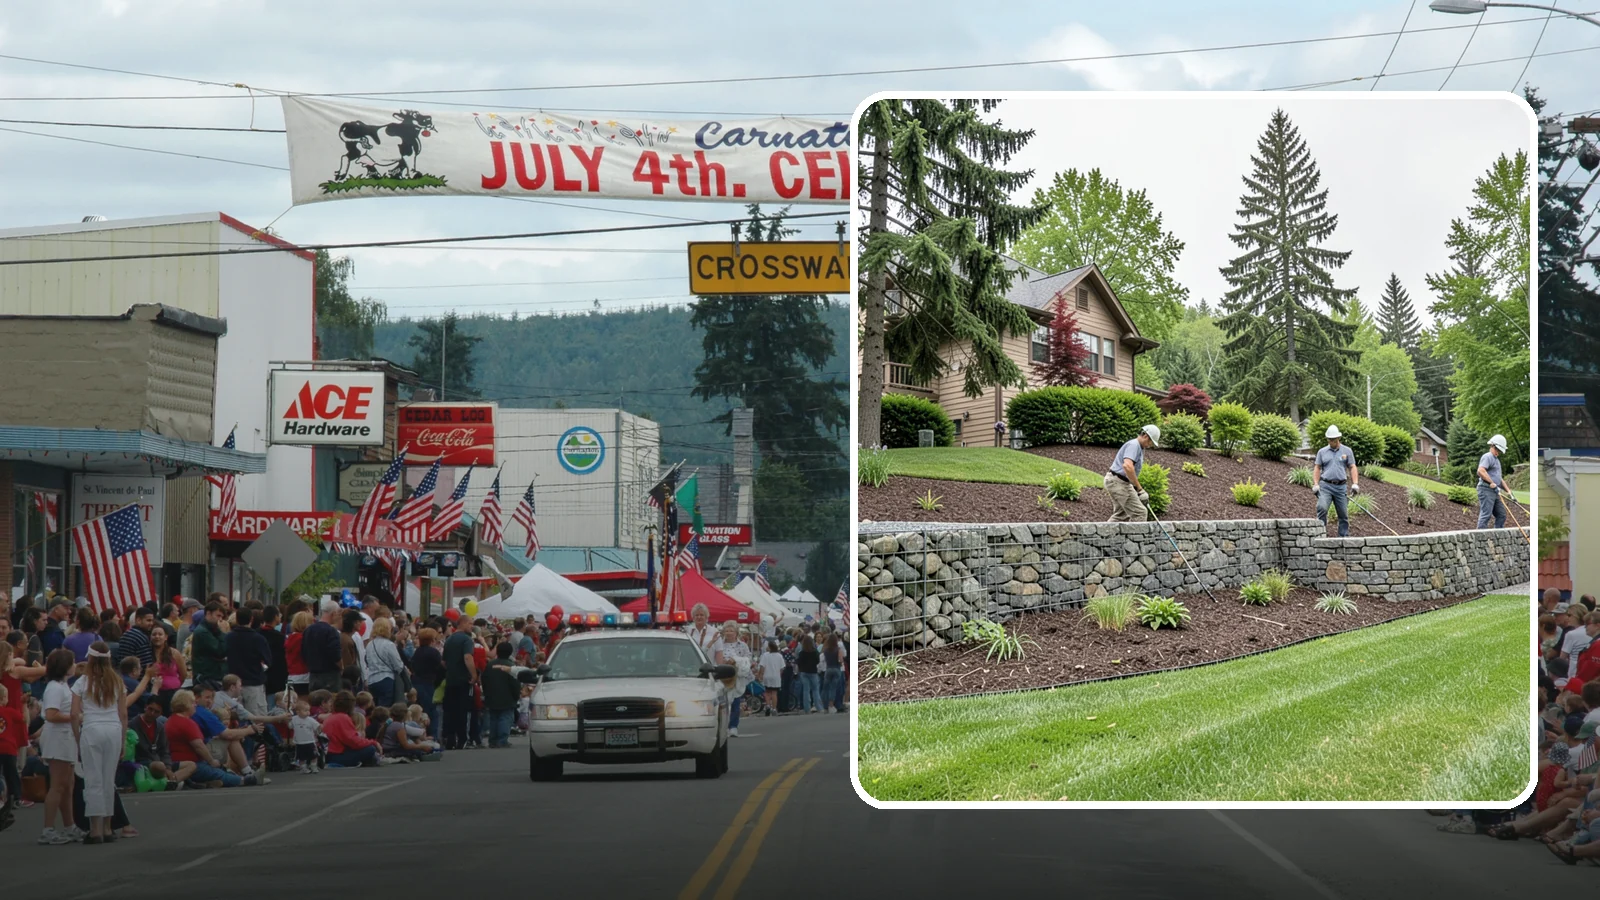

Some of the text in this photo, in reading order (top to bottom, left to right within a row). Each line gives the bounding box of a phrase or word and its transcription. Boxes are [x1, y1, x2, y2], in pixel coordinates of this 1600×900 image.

[481, 141, 605, 193] JULY
[632, 149, 747, 198] 4th.
[696, 254, 850, 280] CROSSWA
[282, 380, 374, 420] ACE
[405, 409, 453, 422] CEDAR
[283, 421, 371, 437] Hardware
[416, 427, 477, 447] Coca-Cola
[95, 484, 124, 495] Vincent
[126, 485, 136, 495] de
[137, 485, 155, 495] Paul
[688, 526, 741, 535] CRNATION
[699, 535, 730, 543] GLASS
